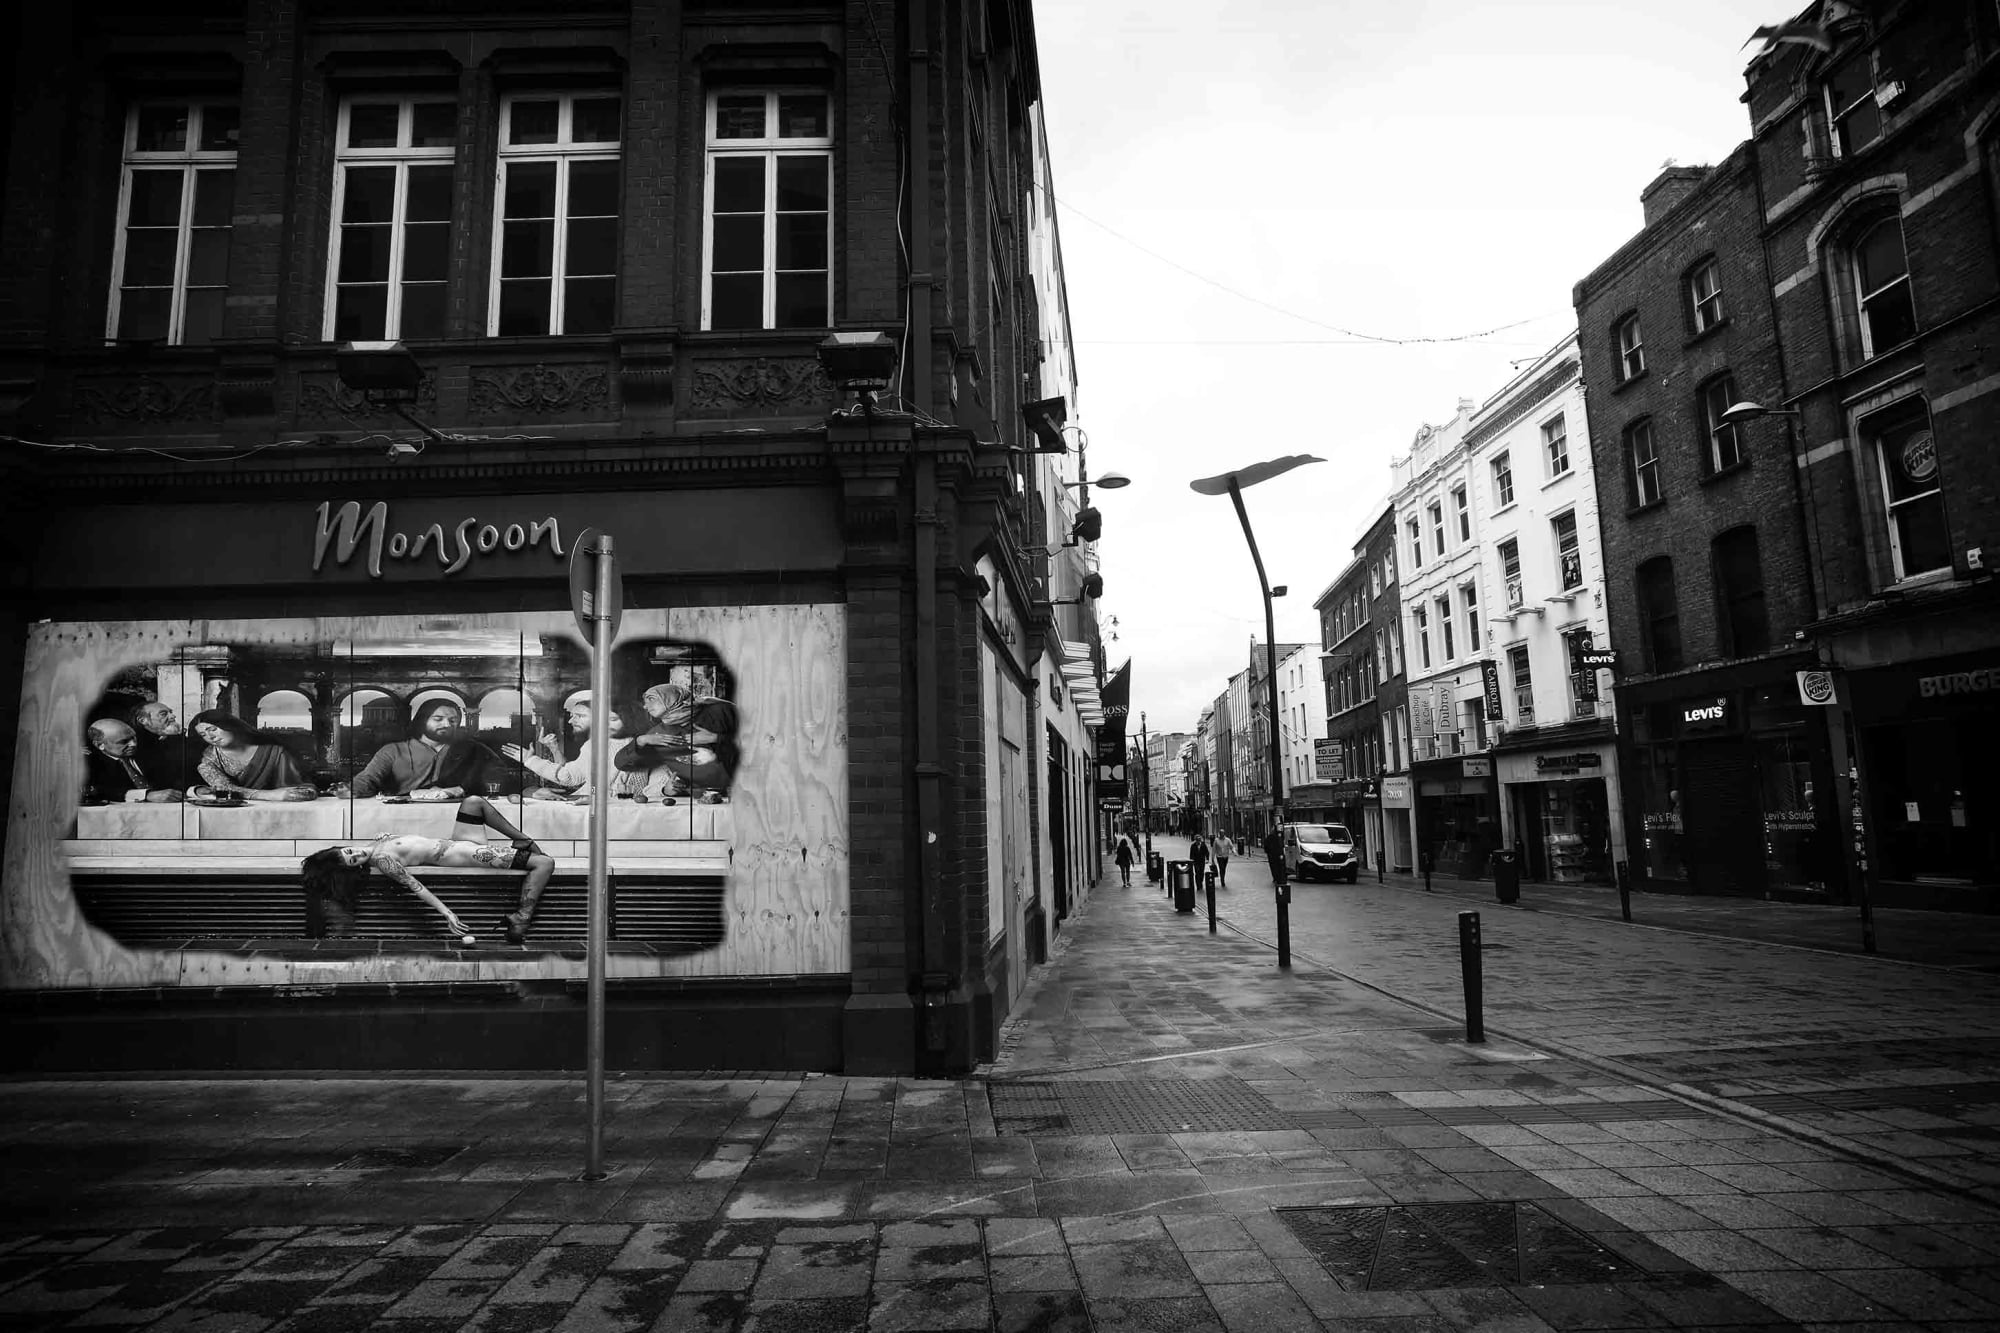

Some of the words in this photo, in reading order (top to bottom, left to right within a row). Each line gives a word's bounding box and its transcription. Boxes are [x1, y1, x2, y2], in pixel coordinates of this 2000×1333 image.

[312, 500, 564, 578] Monsoon
[1487, 667, 1500, 715] CARROLLS
[1807, 677, 1827, 690] BURGER
[1809, 682, 1830, 697] KING
[1413, 694, 1421, 731] Bookshop
[1440, 687, 1450, 728] Dubray
